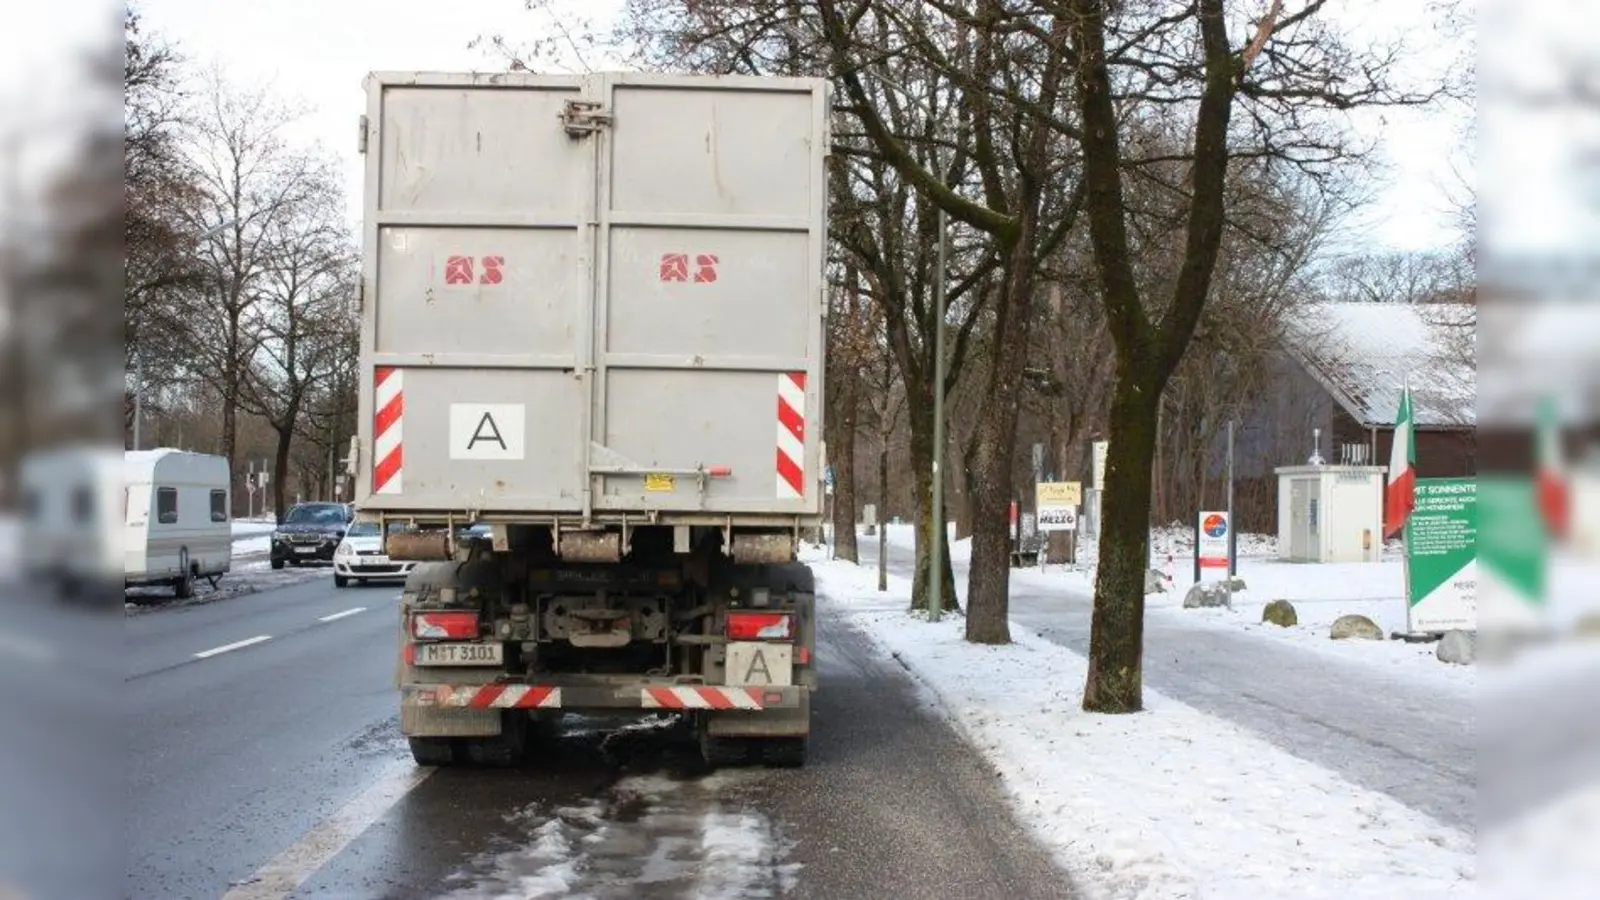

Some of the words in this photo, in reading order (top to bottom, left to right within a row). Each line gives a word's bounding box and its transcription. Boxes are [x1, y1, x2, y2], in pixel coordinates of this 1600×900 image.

[467, 411, 508, 450] A
[428, 646, 438, 660] M
[448, 646, 457, 660] T
[460, 645, 496, 660] 3101
[744, 649, 773, 683] A
